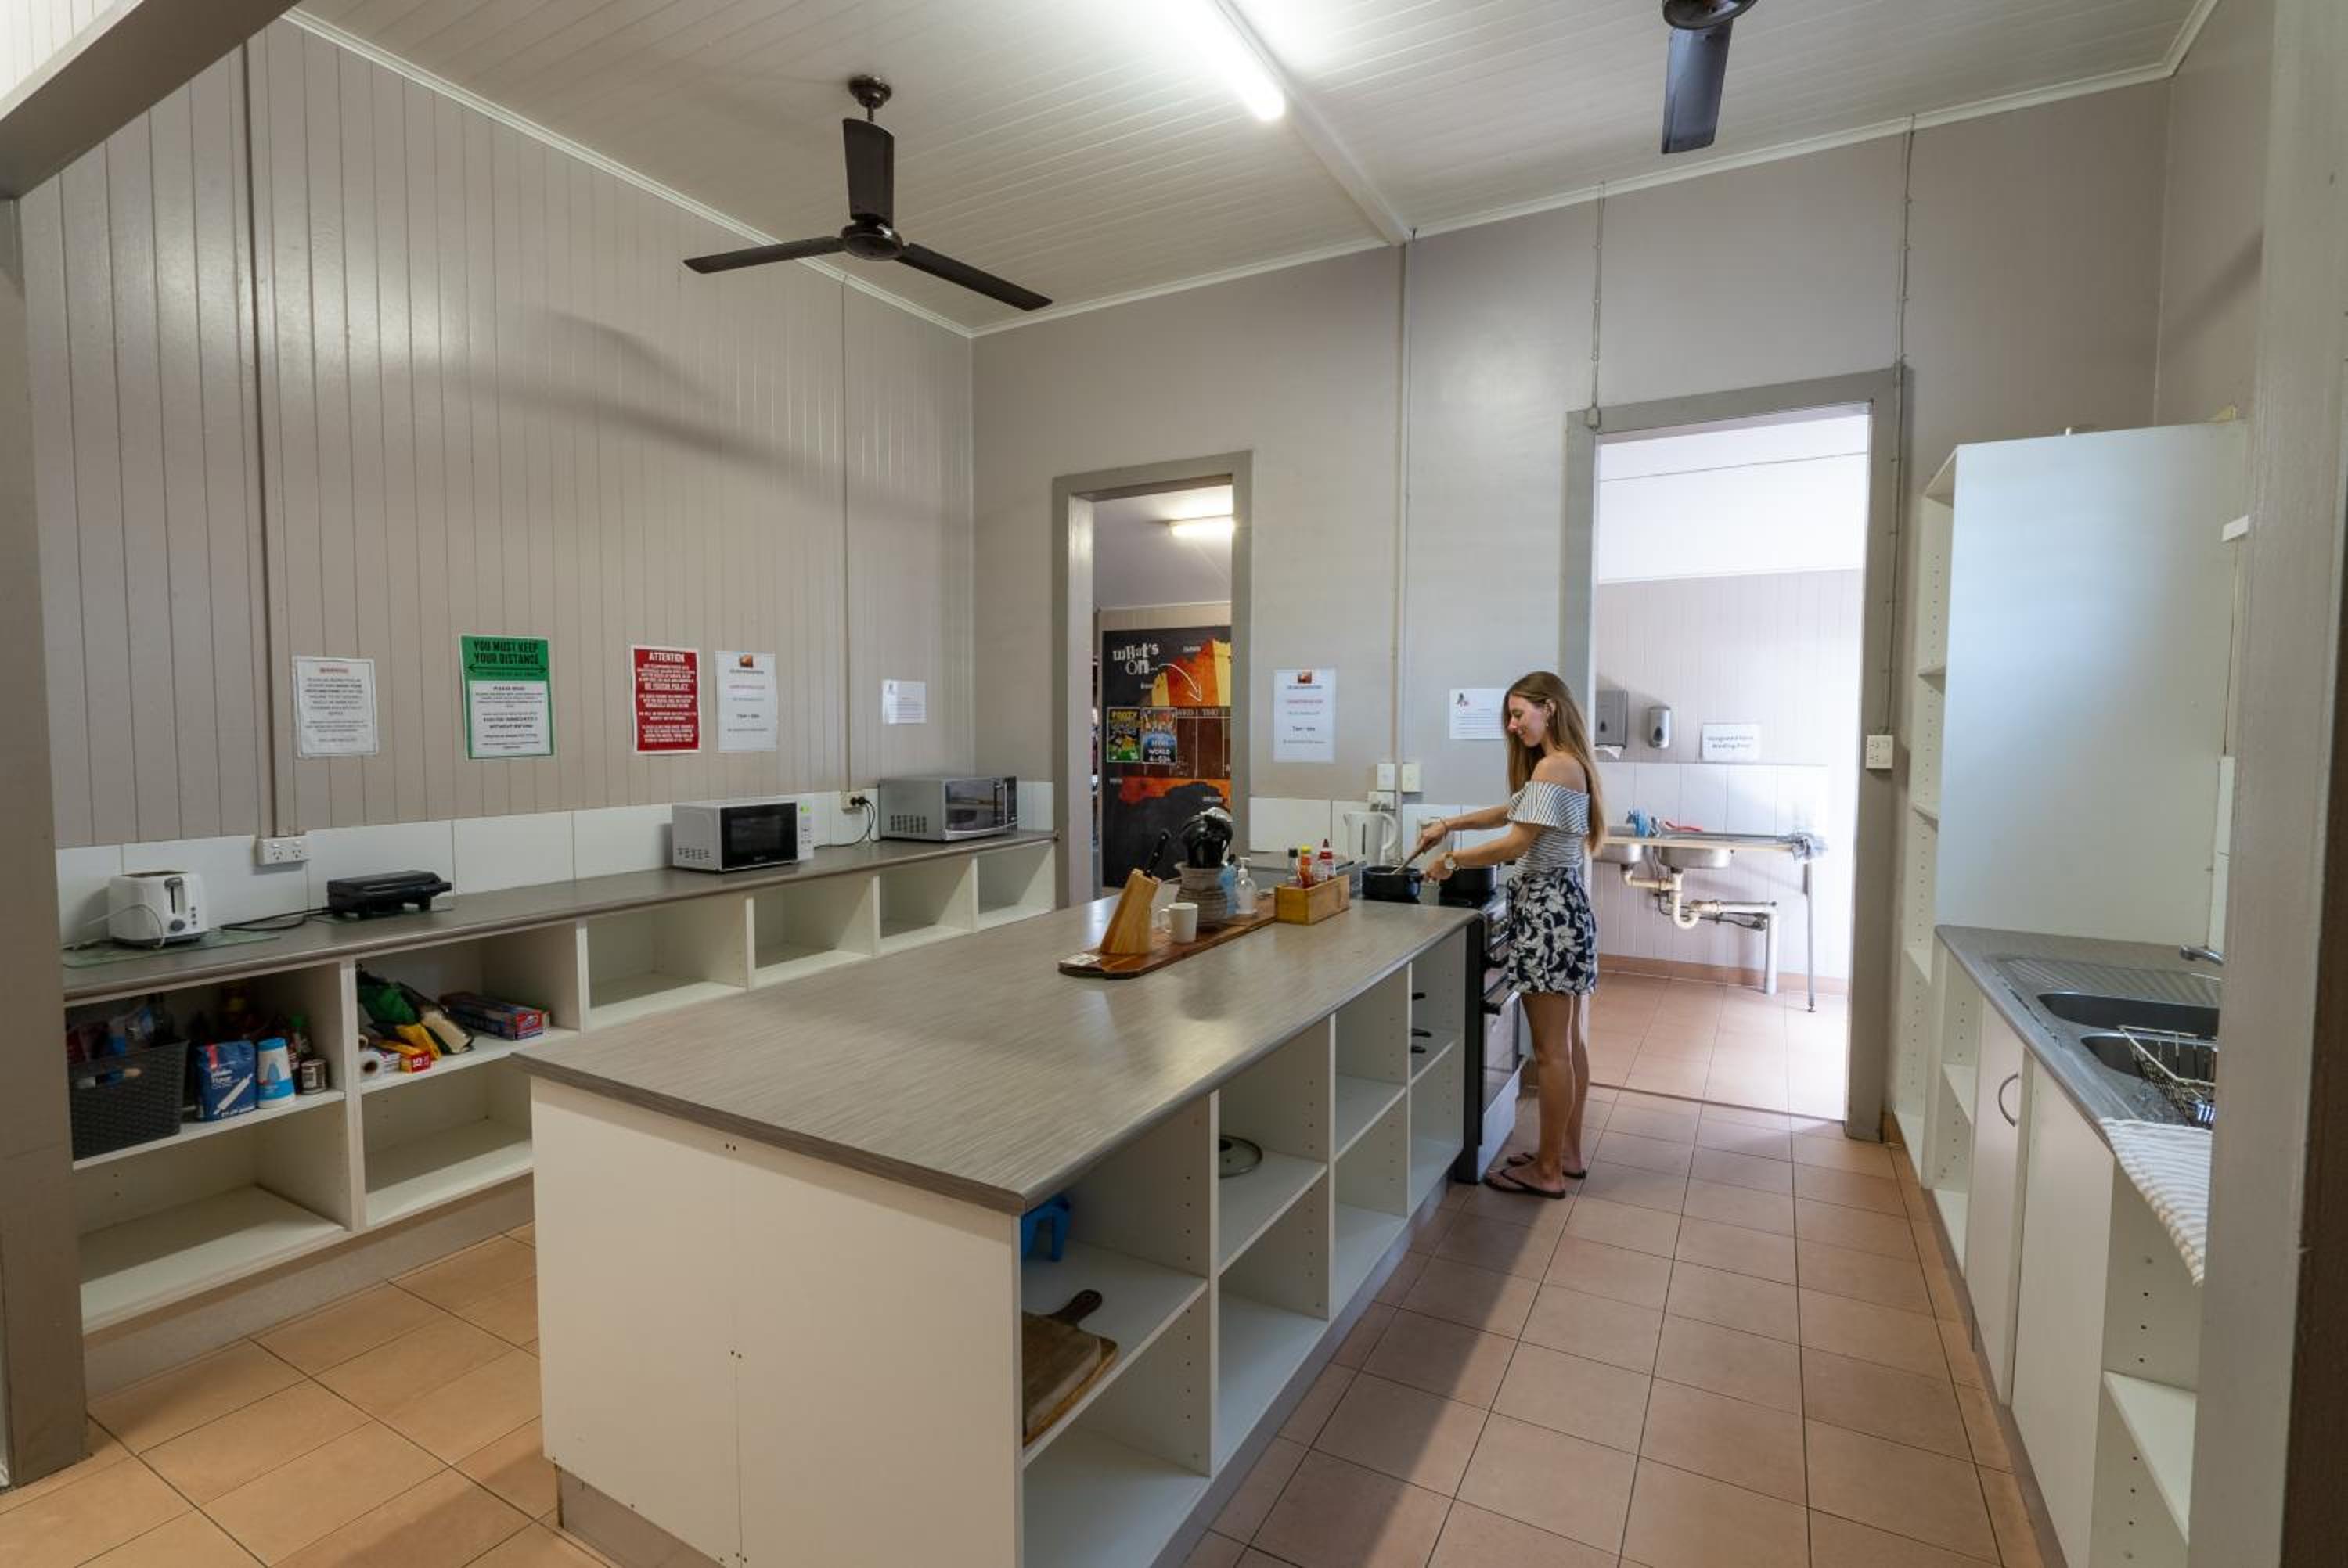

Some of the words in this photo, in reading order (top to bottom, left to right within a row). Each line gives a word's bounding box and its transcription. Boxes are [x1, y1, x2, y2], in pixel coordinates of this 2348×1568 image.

[474, 640, 490, 651] YOU
[492, 641, 515, 652] MUST
[518, 642, 539, 653] KEEP
[474, 653, 497, 664] YOUR
[499, 653, 539, 664] DISTANCE
[649, 652, 685, 663] ATTENTION
